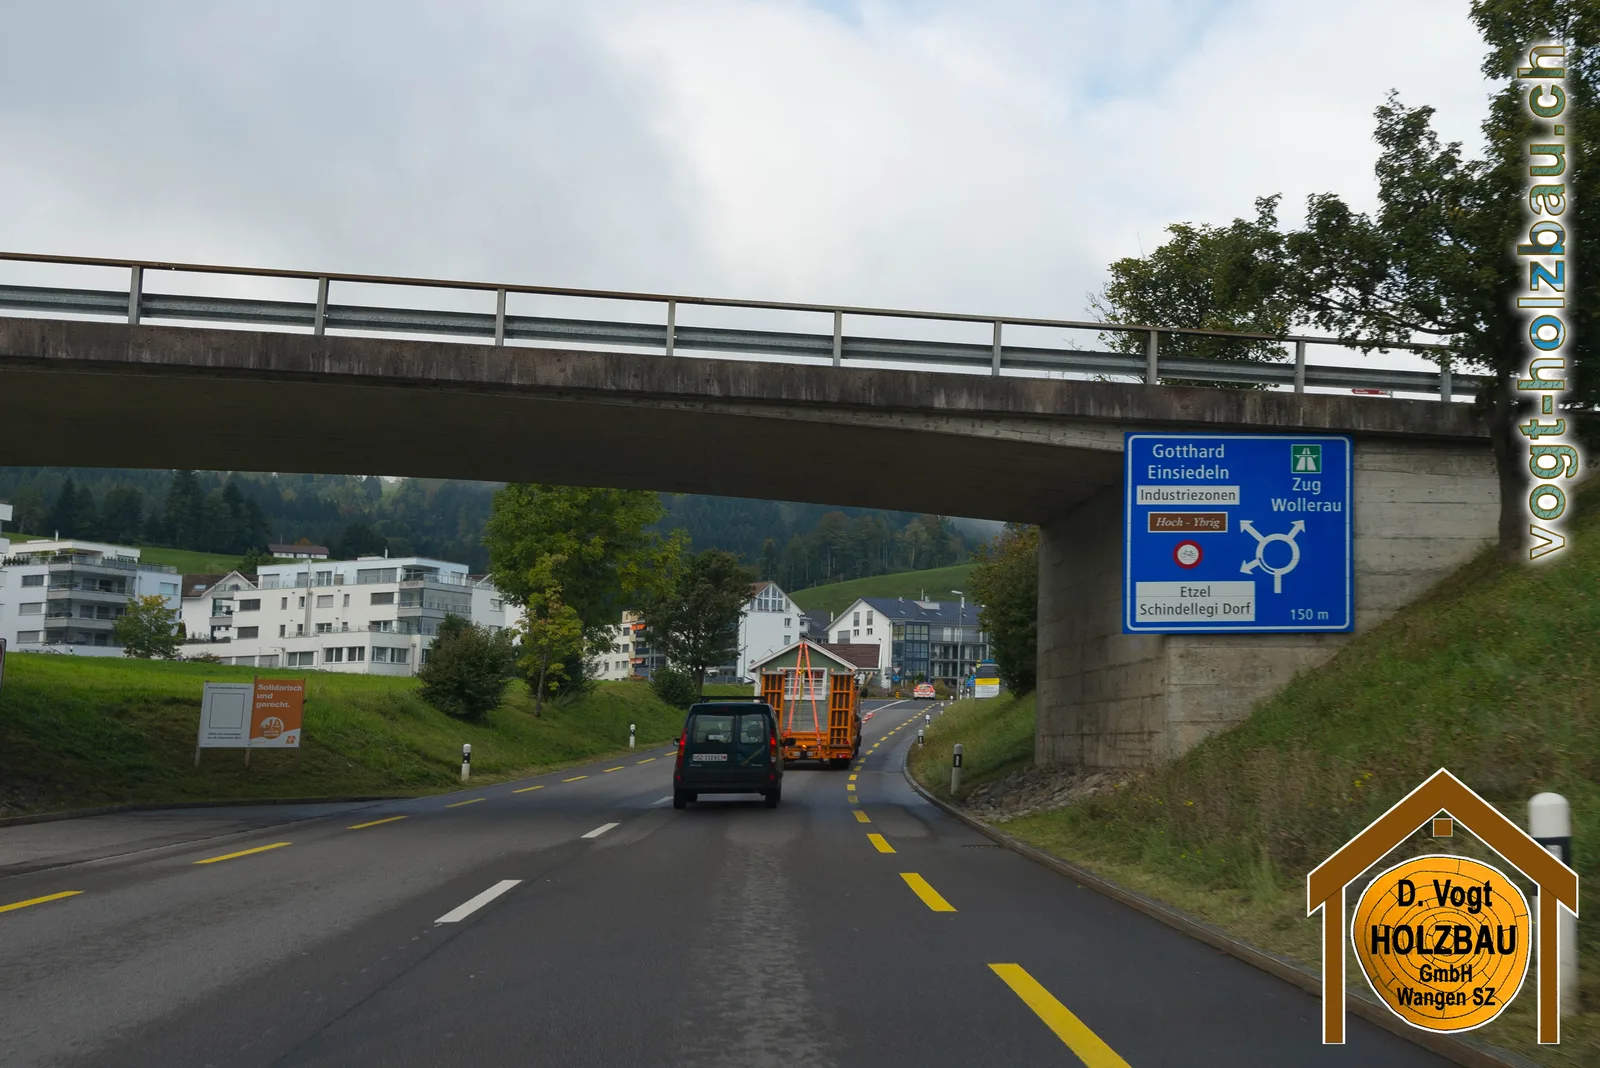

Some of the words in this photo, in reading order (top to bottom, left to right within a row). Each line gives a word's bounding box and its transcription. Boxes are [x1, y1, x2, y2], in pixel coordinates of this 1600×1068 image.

[1152, 443, 1225, 459] Gotthard
[1147, 464, 1230, 480] Einsiedeln
[1292, 477, 1321, 495] Zug
[1140, 488, 1236, 501] Industriezonen
[1271, 498, 1342, 512] Wollerau
[1155, 517, 1183, 527] Hoch
[1193, 517, 1221, 530] Ybrig
[1180, 586, 1211, 598] Etzel
[1139, 602, 1219, 618] Schindellegi
[1222, 602, 1252, 615] Dorf
[1290, 608, 1314, 620] 150
[1317, 611, 1329, 620] m
[257, 683, 303, 692] Solidarisch
[255, 701, 290, 709] gerecht.
